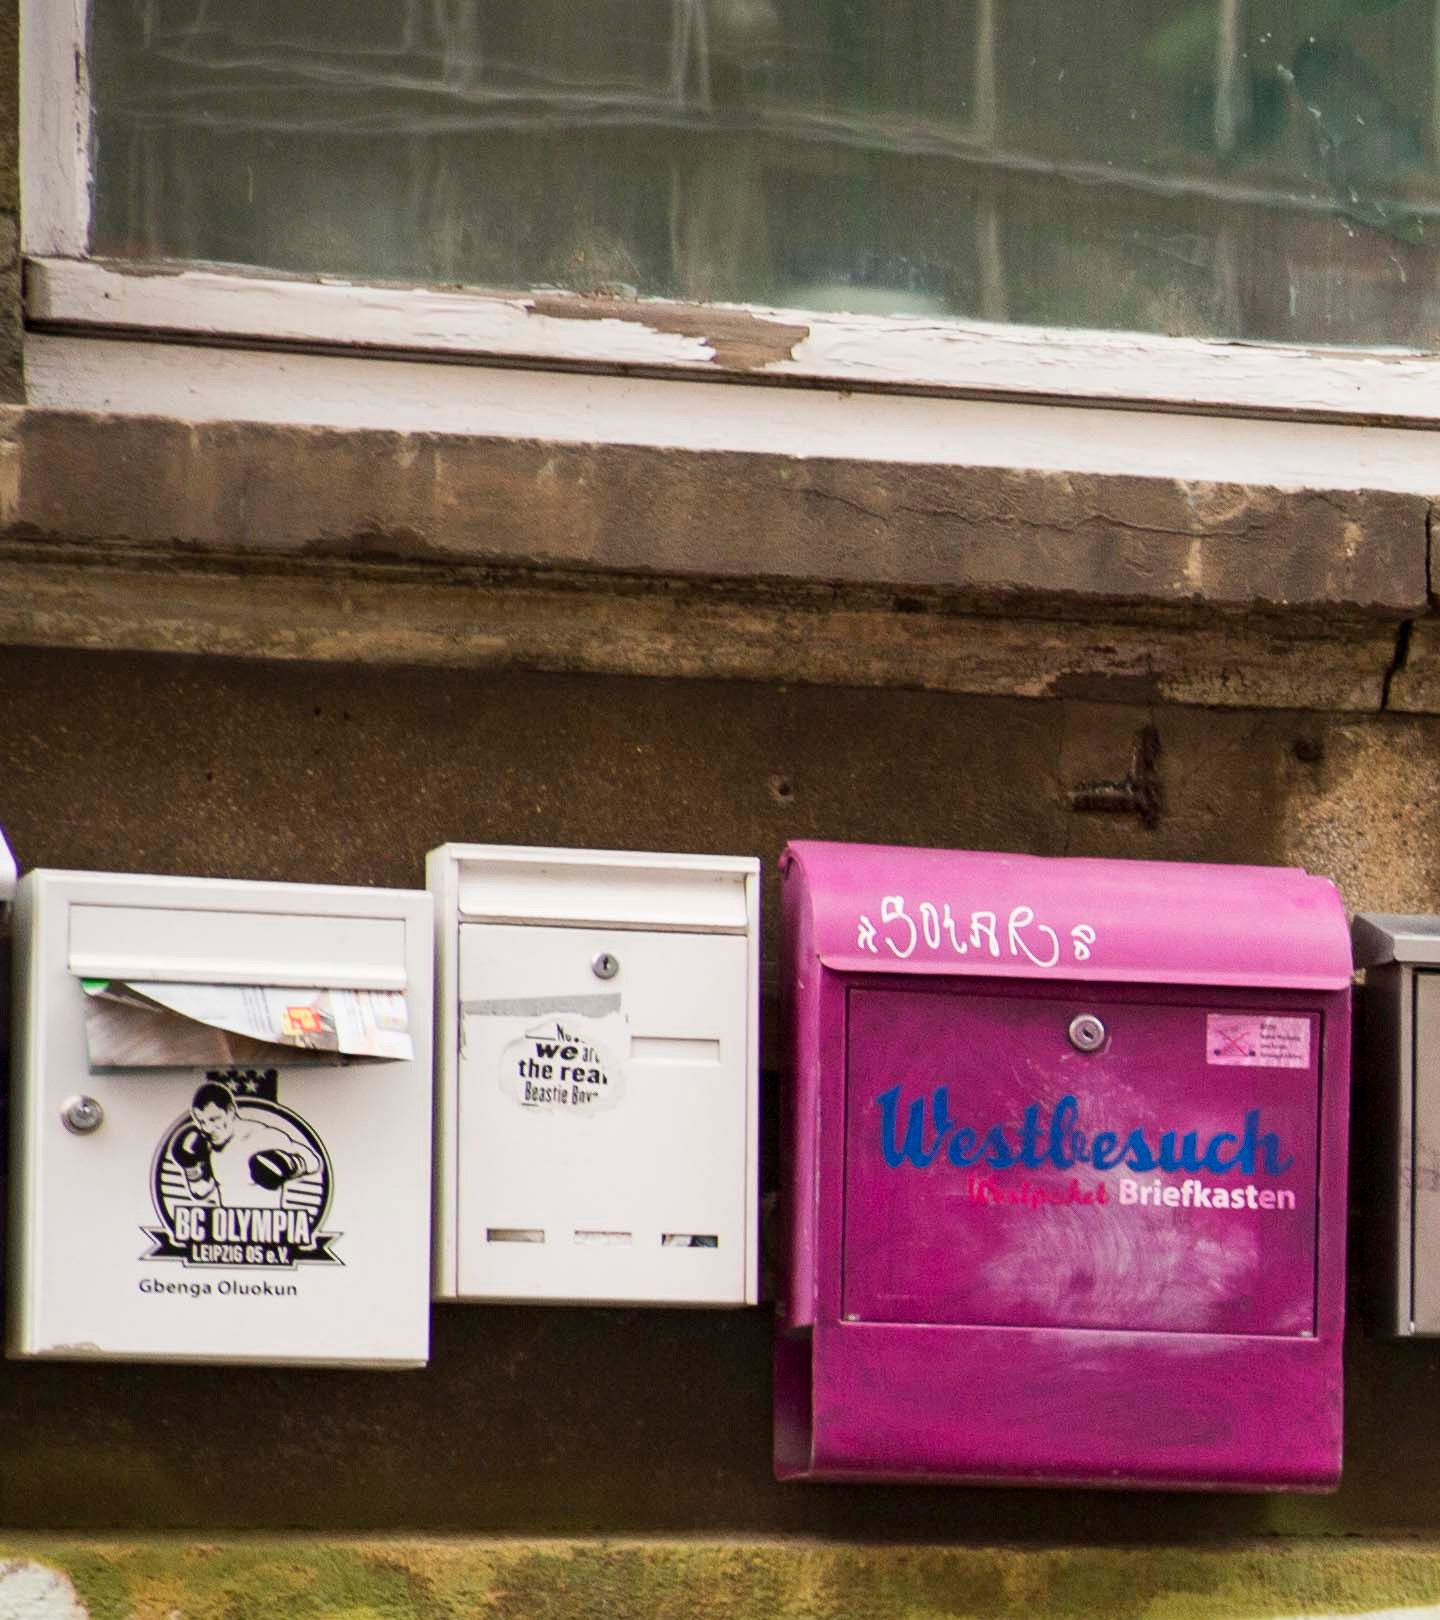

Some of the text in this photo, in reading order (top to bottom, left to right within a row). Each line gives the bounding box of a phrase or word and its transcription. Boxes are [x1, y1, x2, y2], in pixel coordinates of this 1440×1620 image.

[535, 1042, 579, 1060] we
[518, 1058, 553, 1080] the
[525, 1080, 569, 1104] Beastie
[876, 1084, 1297, 1176] Westbesuch
[1119, 1178, 1296, 1210] Briefkasten
[175, 1207, 311, 1244] BC OLYMPIA
[192, 1244, 289, 1264] LEIPZIG 05 e.V.
[139, 1278, 298, 1297] Gbenga Oluokun
